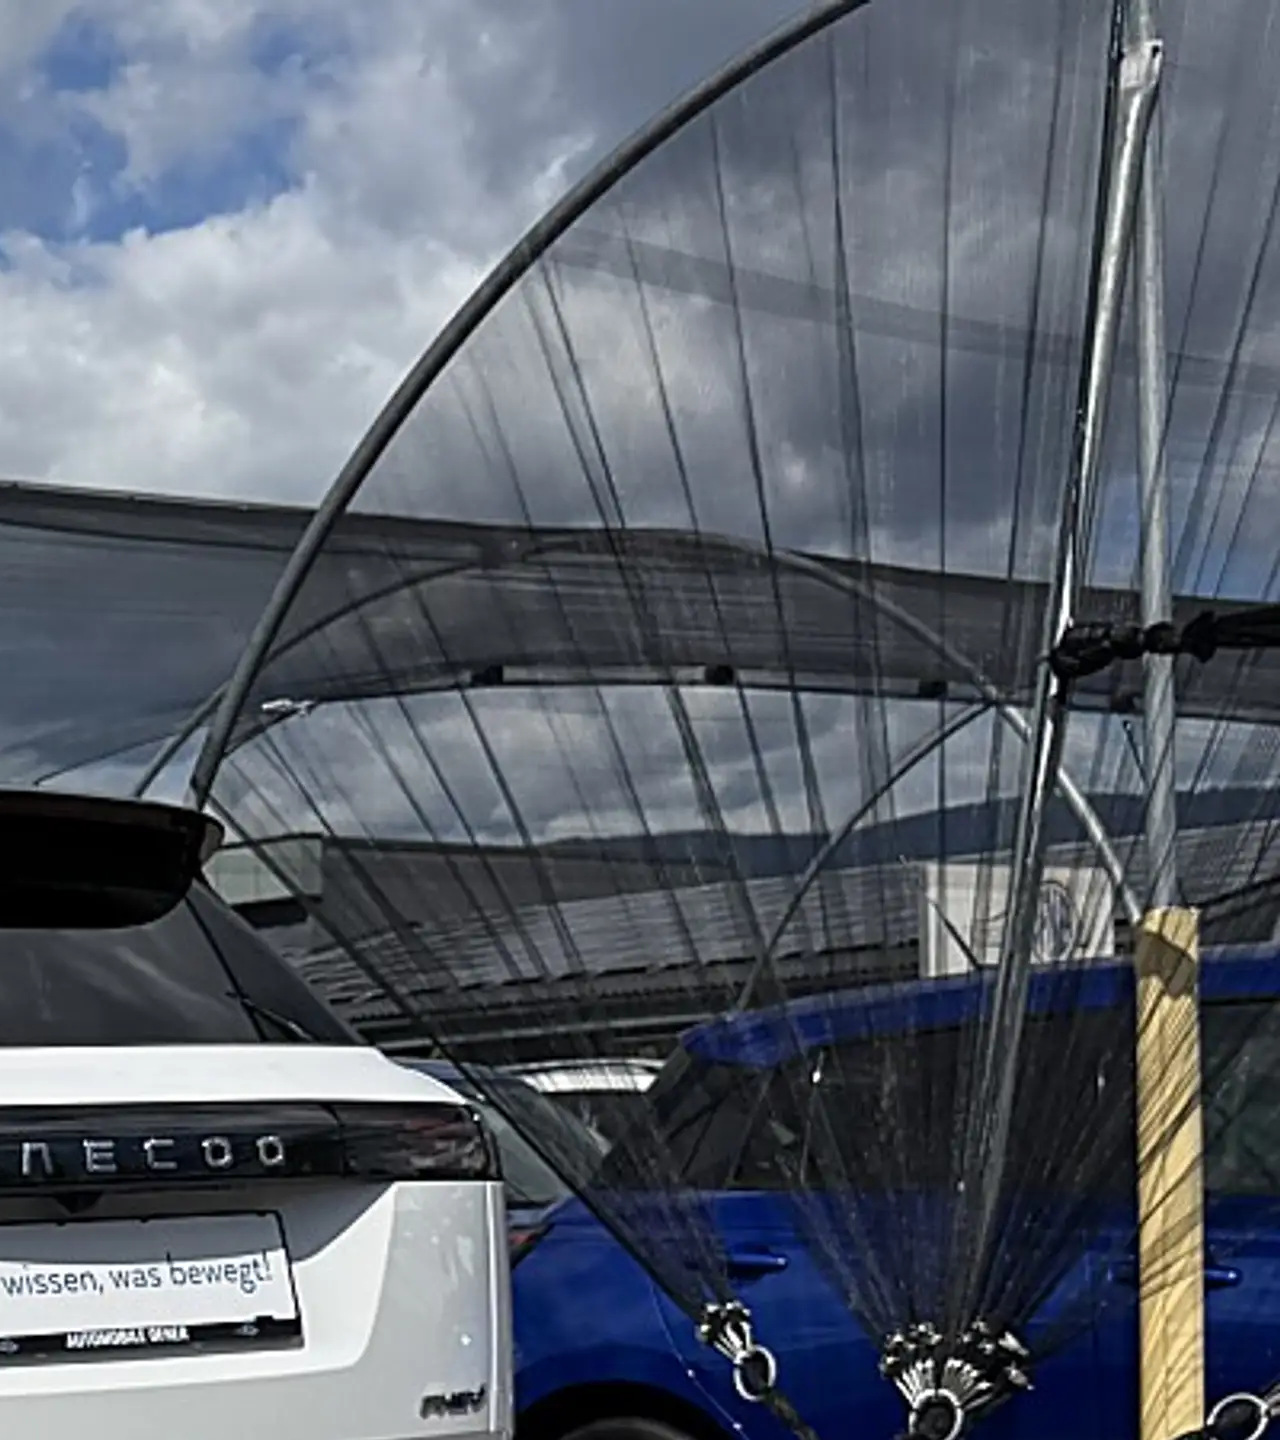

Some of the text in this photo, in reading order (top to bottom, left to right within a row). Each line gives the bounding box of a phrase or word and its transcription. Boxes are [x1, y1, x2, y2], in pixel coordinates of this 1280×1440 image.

[0, 1264, 104, 1295] wissen,
[108, 1266, 162, 1288] was
[166, 1251, 274, 1295] bewegt!
